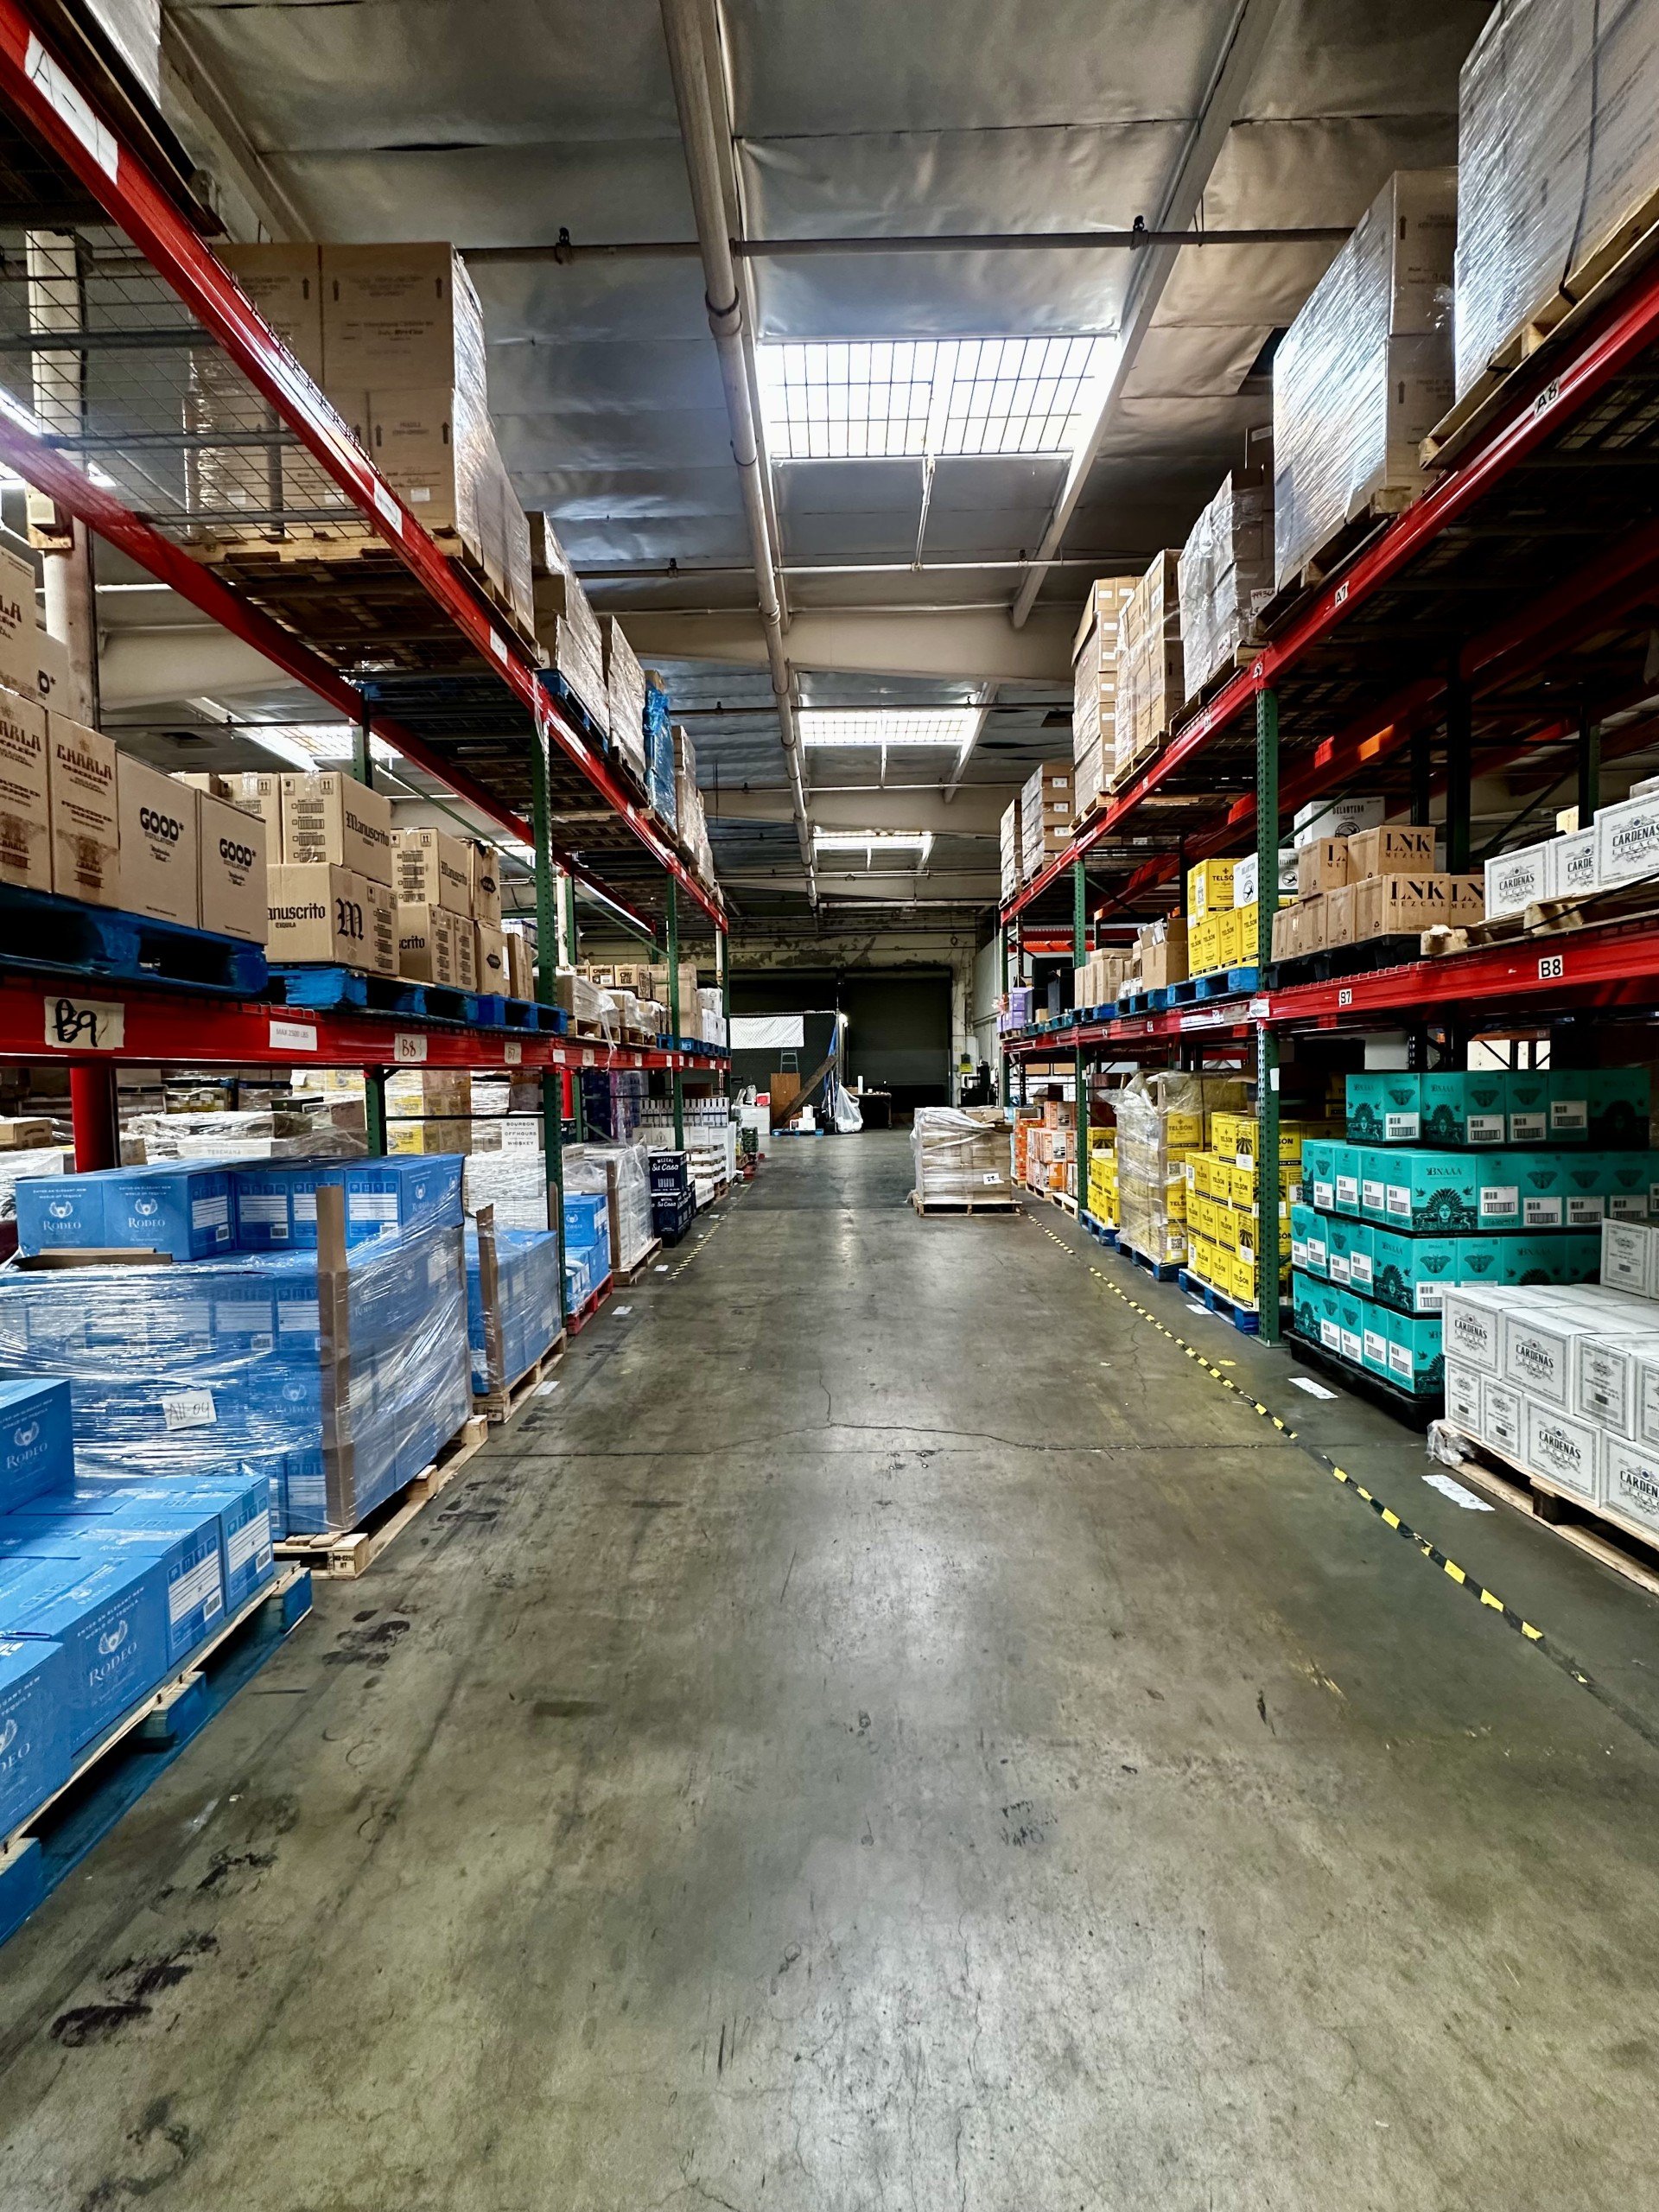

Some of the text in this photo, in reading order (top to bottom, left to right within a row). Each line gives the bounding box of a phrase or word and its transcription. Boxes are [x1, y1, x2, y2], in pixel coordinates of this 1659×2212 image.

[1536, 380, 1558, 413] A8
[1336, 585, 1347, 603] A7
[56, 743, 112, 780] CHARLA
[346, 810, 390, 847] Manuscrito
[1499, 873, 1535, 891] CARDENAS
[1541, 958, 1561, 978] B8
[43, 1220, 81, 1231] RODEO
[128, 1217, 165, 1229] RODEO
[1454, 1319, 1488, 1339] CARDENAS
[1516, 1344, 1554, 1369] CARDENAS
[7, 1442, 48, 1469] RODEO
[1539, 1430, 1581, 1460] CARDENAS
[78, 1618, 96, 1637] ENTER
[106, 1595, 131, 1616] ELEGANT
[132, 1586, 144, 1596] NEW
[86, 1623, 105, 1640] WORLD
[116, 1599, 139, 1618] TEQUILA
[89, 1641, 137, 1687] RODEO
[24, 1675, 41, 1690] NEW
